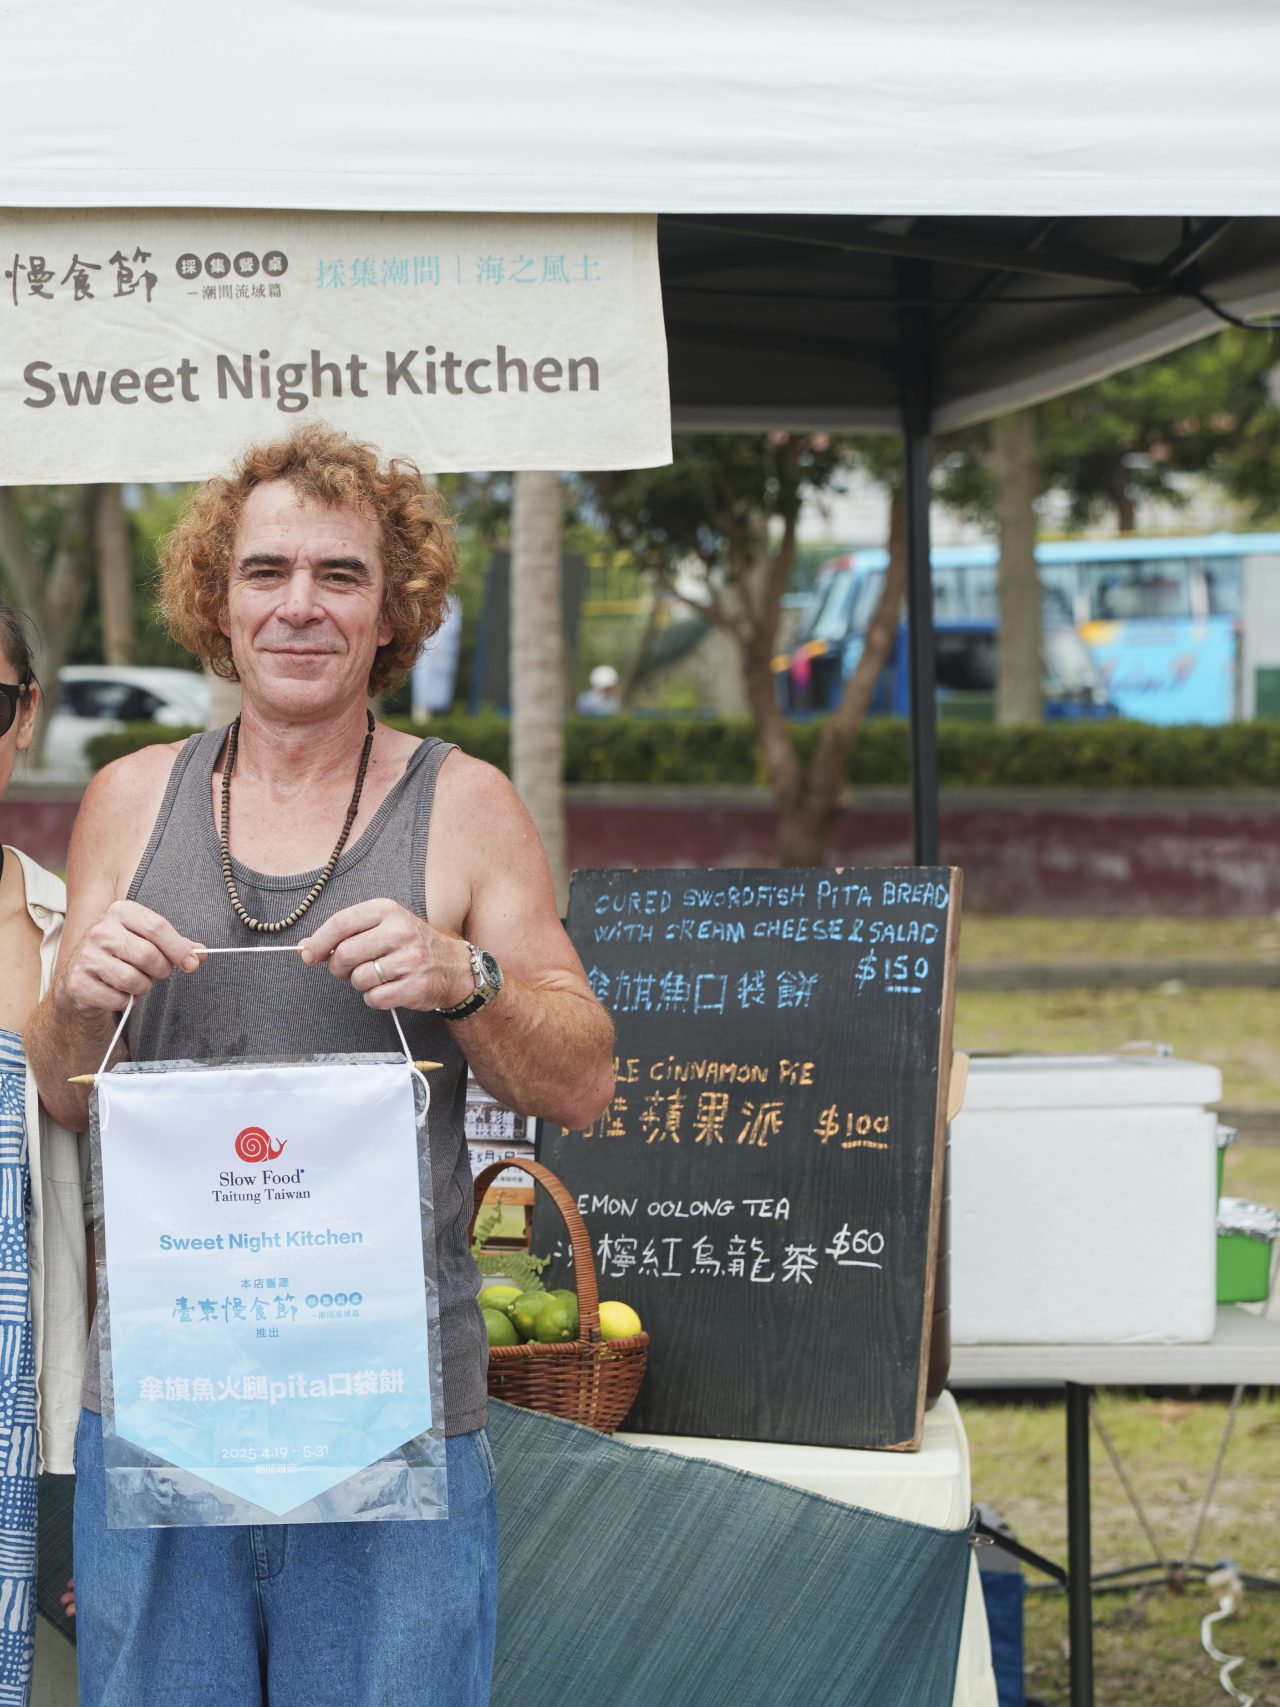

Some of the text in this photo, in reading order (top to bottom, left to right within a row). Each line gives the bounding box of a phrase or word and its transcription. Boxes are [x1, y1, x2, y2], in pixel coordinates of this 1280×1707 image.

[178, 252, 286, 278] 採集餐桌
[23, 358, 200, 408] Sweet
[217, 349, 369, 413] Night
[386, 344, 599, 396] Kitchen
[594, 890, 672, 914] CURED
[882, 881, 949, 909] BREAD
[665, 918, 745, 944] CREAM
[753, 918, 844, 942] CHEESE
[869, 921, 938, 944] SALAD
[854, 948, 929, 996] $150
[561, 1087, 785, 1146] 桂蘋果派
[814, 1104, 889, 1145] $100
[219, 1169, 301, 1187] Slow Food
[212, 1188, 310, 1204] Taitung Taiwan
[576, 1194, 790, 1220] EMON OOLONG TEA
[160, 1229, 363, 1252] Sweet Night Kitchen
[825, 1223, 885, 1261] $60
[172, 1293, 298, 1323] 臺東慢食節
[256, 1328, 279, 1338] 推出
[221, 1446, 288, 1460] 2025.4.19
